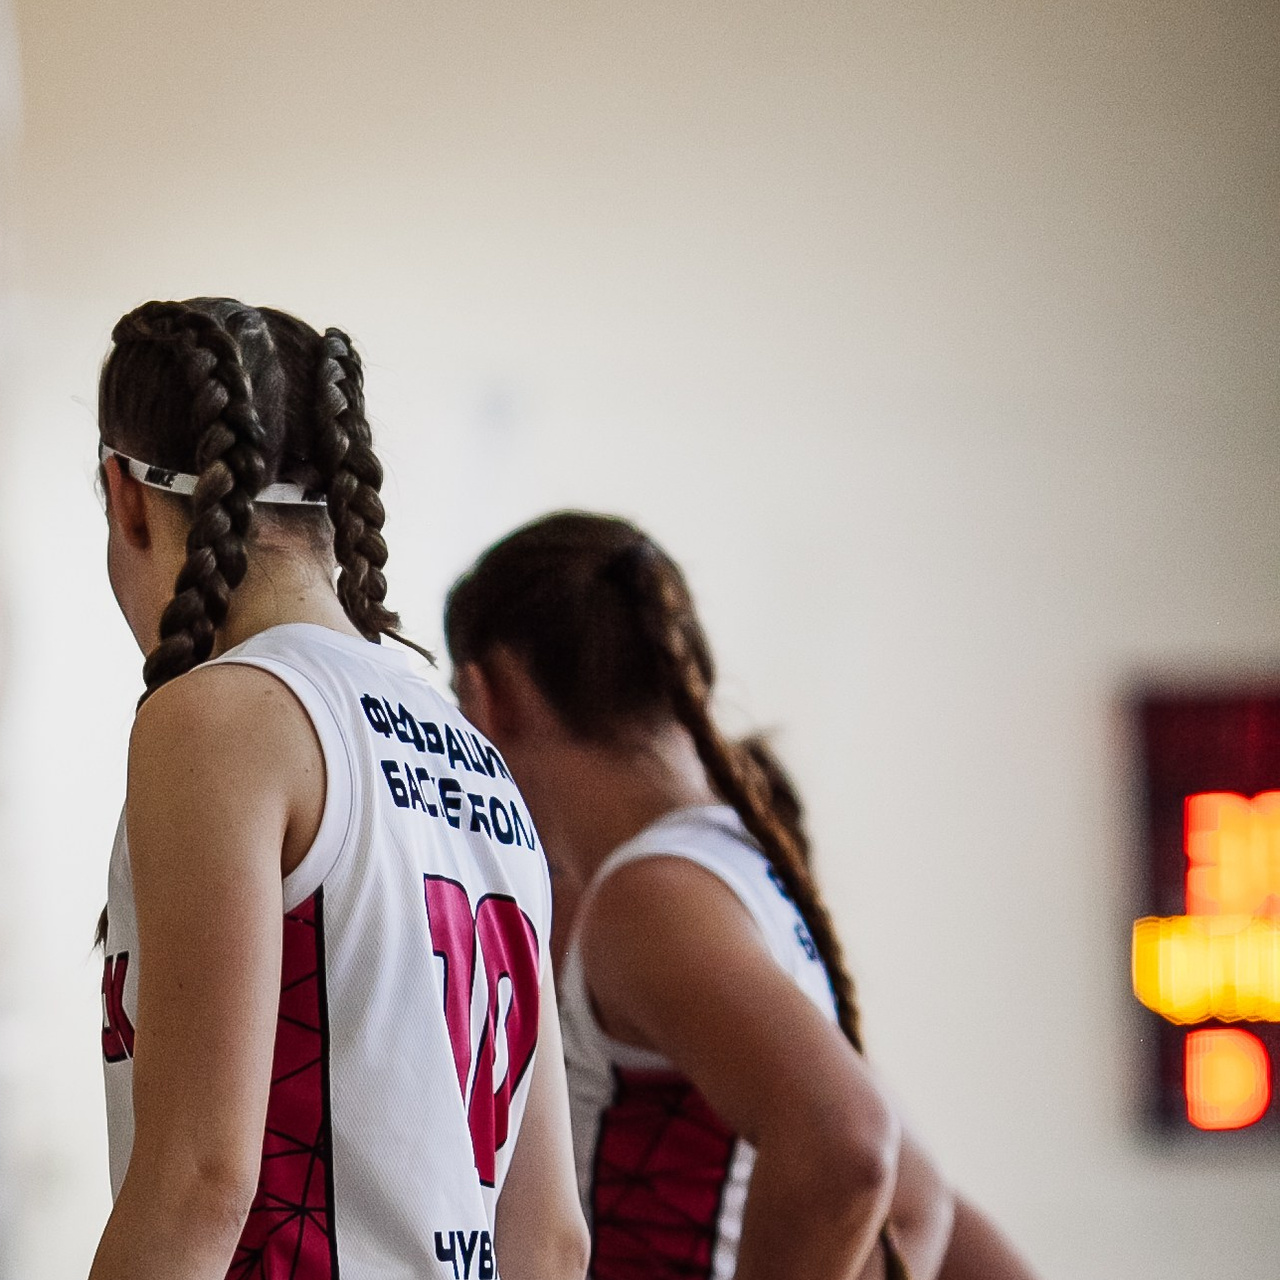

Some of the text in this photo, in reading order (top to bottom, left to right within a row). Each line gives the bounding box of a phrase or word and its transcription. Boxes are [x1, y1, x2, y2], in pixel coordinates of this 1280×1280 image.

[380, 760, 536, 851] БАСЕБОЛ
[422, 873, 541, 1189] 10
[434, 1230, 498, 1280] ЧУВ
